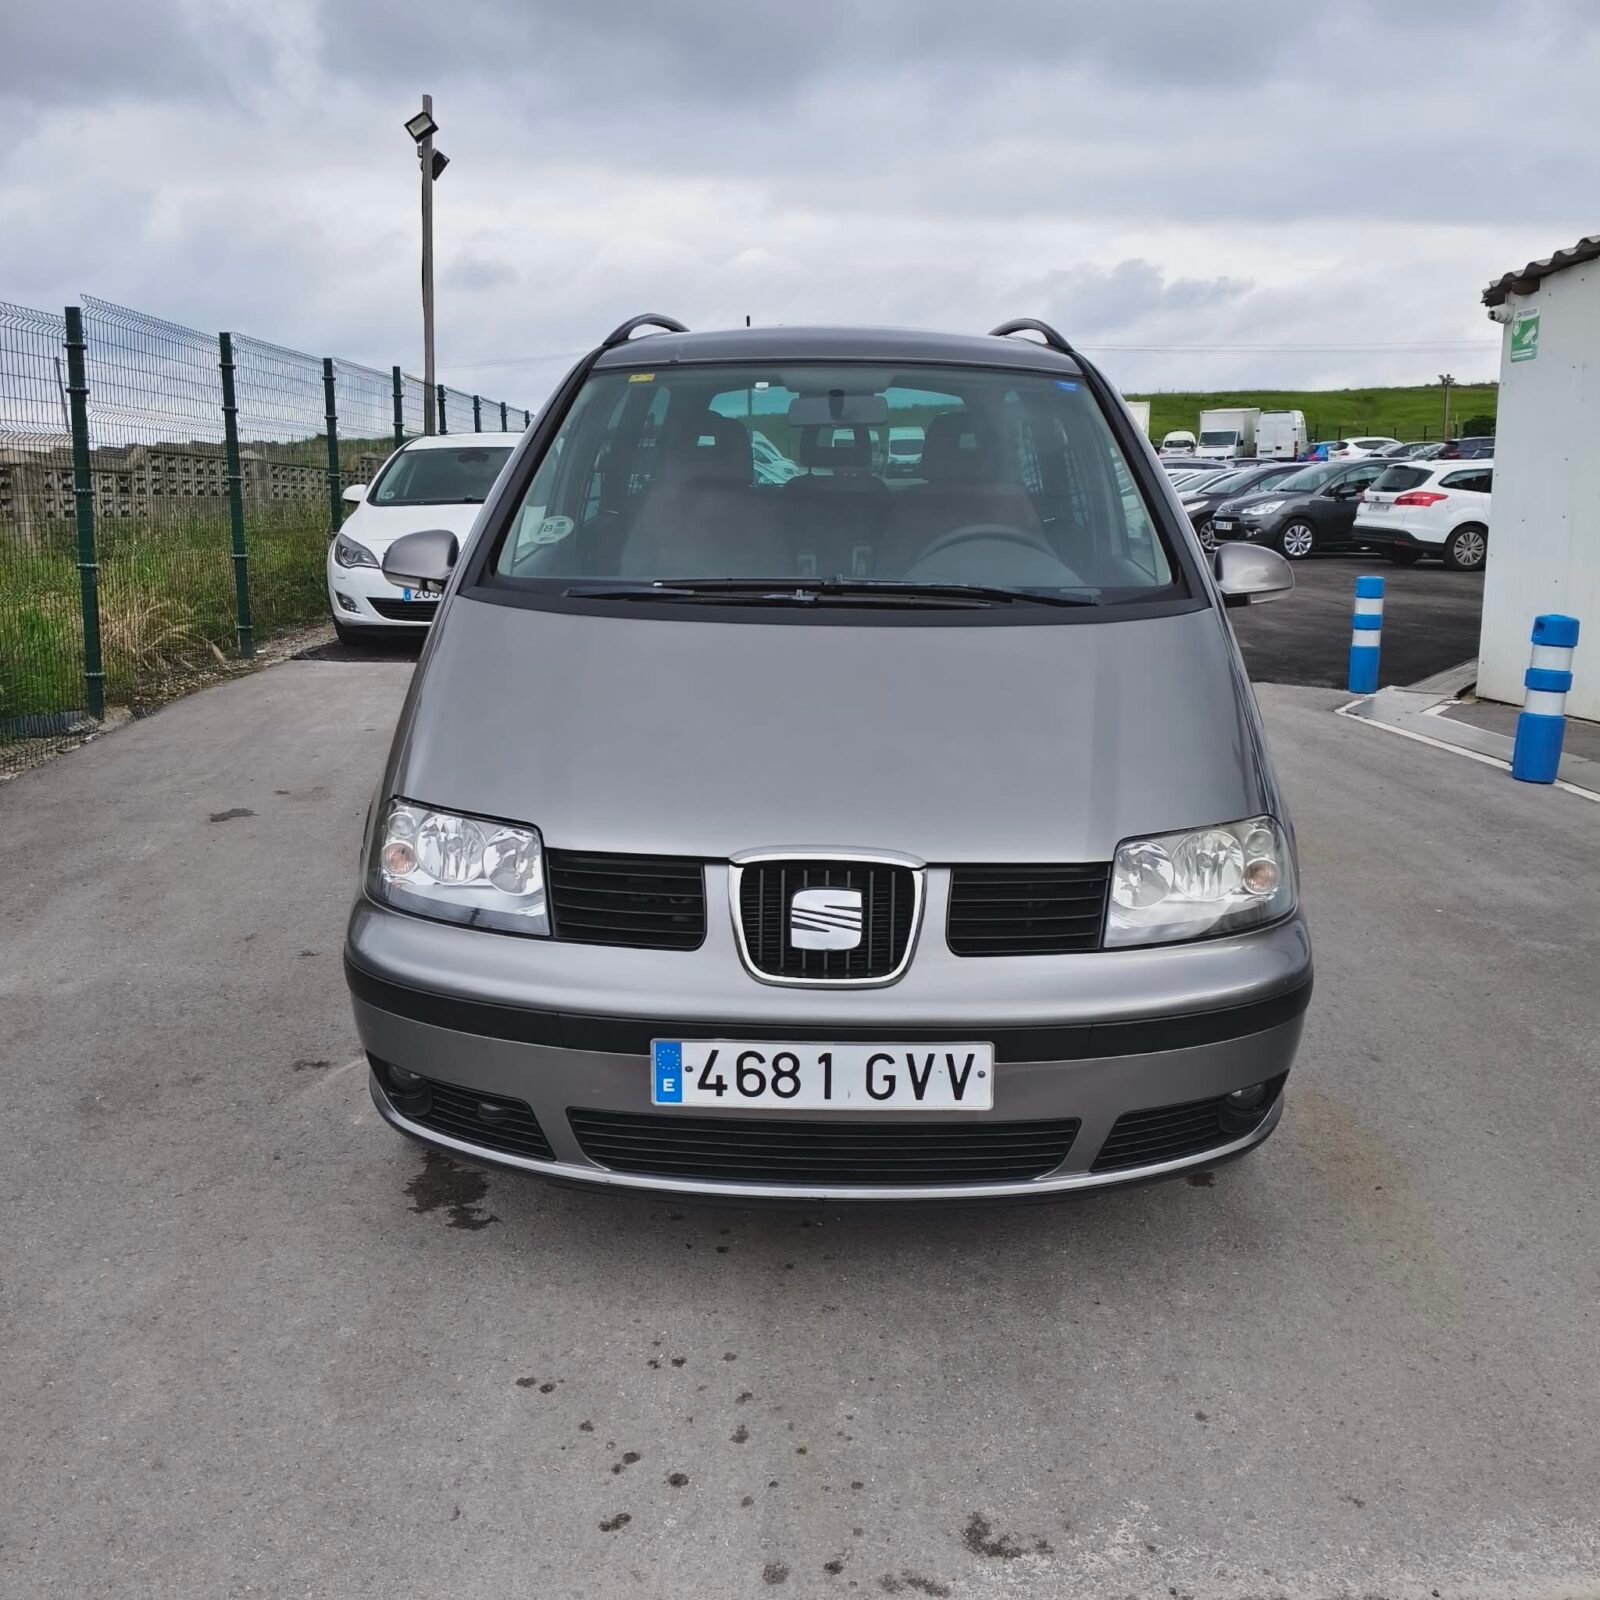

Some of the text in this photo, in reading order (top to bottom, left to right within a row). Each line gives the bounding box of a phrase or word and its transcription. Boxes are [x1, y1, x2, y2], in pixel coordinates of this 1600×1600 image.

[663, 1078, 675, 1092] E
[697, 1050, 975, 1101] 4681 GVV
